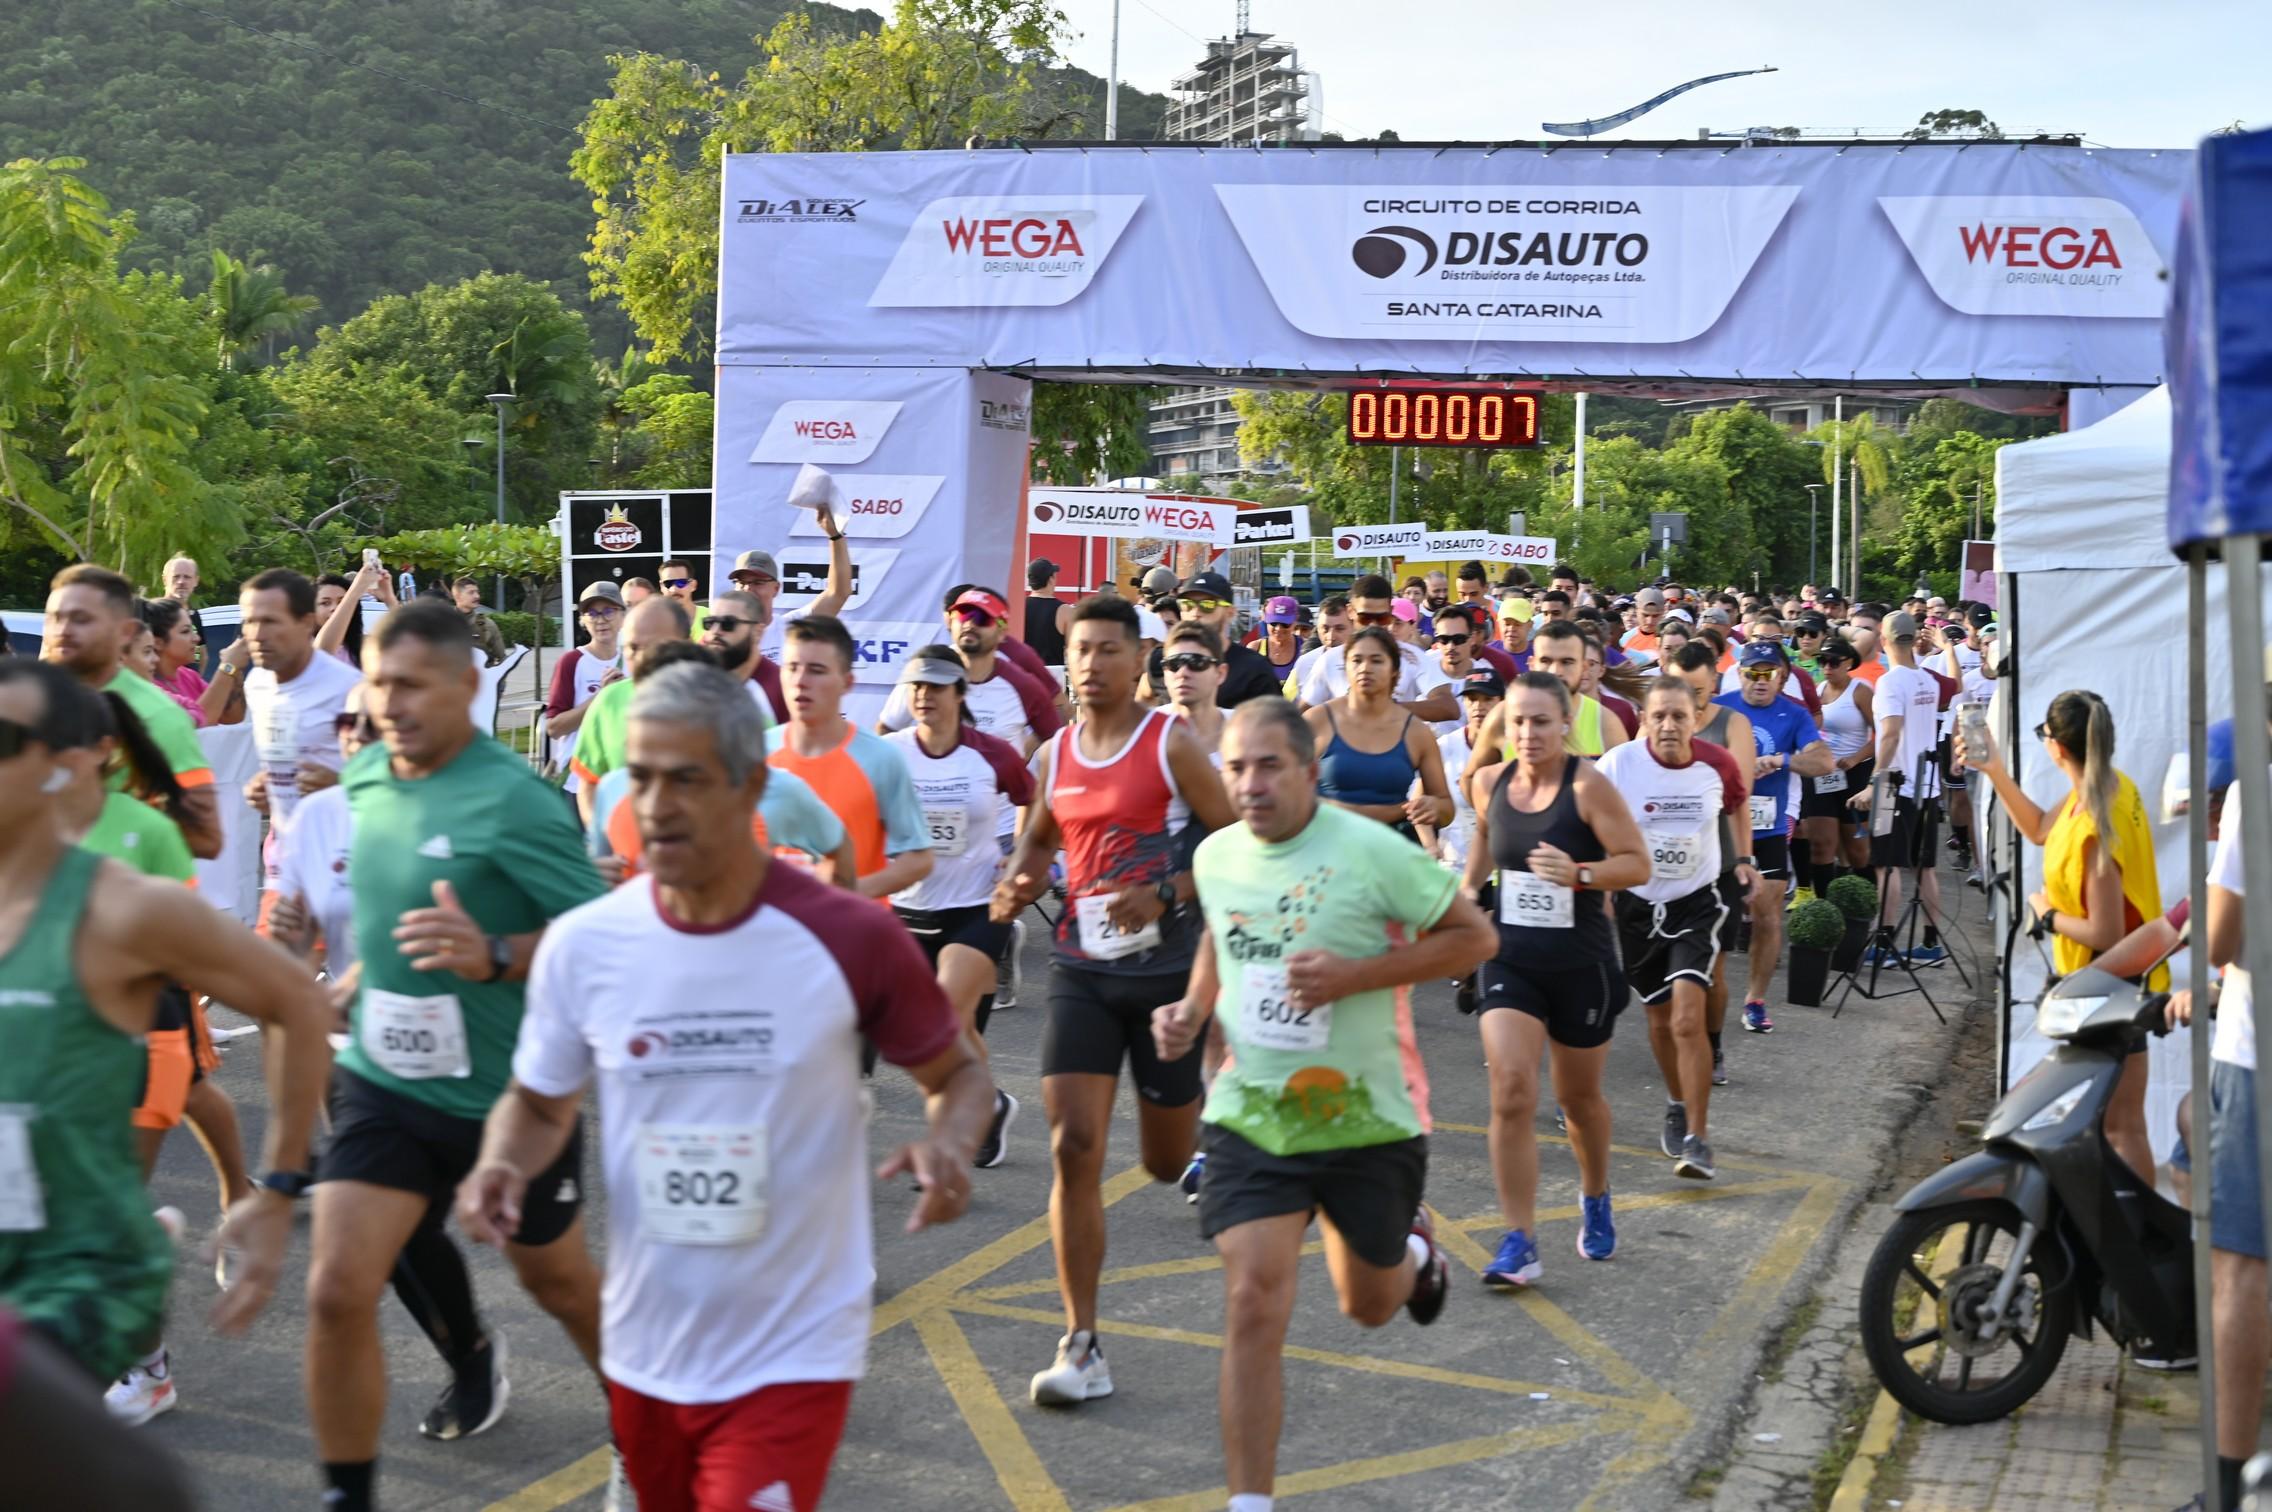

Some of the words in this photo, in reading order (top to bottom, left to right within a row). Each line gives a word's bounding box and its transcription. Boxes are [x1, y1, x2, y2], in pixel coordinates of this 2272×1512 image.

[1363, 200, 1482, 214] CIRCUITO
[1488, 200, 1521, 214] DE
[1526, 201, 1641, 214] CORRIDA
[943, 216, 1085, 258] WEGA
[1959, 221, 2123, 270] WEGA
[1444, 231, 1649, 266] DISAUTO
[983, 261, 1036, 273] ORIGINAL
[1039, 262, 1086, 273] QUALITY
[1441, 270, 1520, 281] Distribuidora
[1524, 271, 1539, 281] de
[1543, 271, 1610, 284] Autopeças
[1614, 272, 1646, 282] Ltda.
[2006, 272, 2065, 285] ORIGINAL
[2069, 273, 2123, 287] QUALITY
[1387, 303, 1472, 317] SANTA
[1477, 303, 1602, 318] CATARINA
[794, 420, 856, 439] WEGA
[1067, 504, 1140, 521] DISAUTO
[1145, 505, 1215, 531] WEGA
[1236, 520, 1294, 540] Parker
[1363, 531, 1421, 546] DISAUTO
[1432, 538, 1485, 550] DISAUTO
[853, 639, 908, 663] KF
[1653, 848, 1687, 865] 900
[1517, 893, 1555, 911] 653
[1258, 998, 1314, 1027] 602
